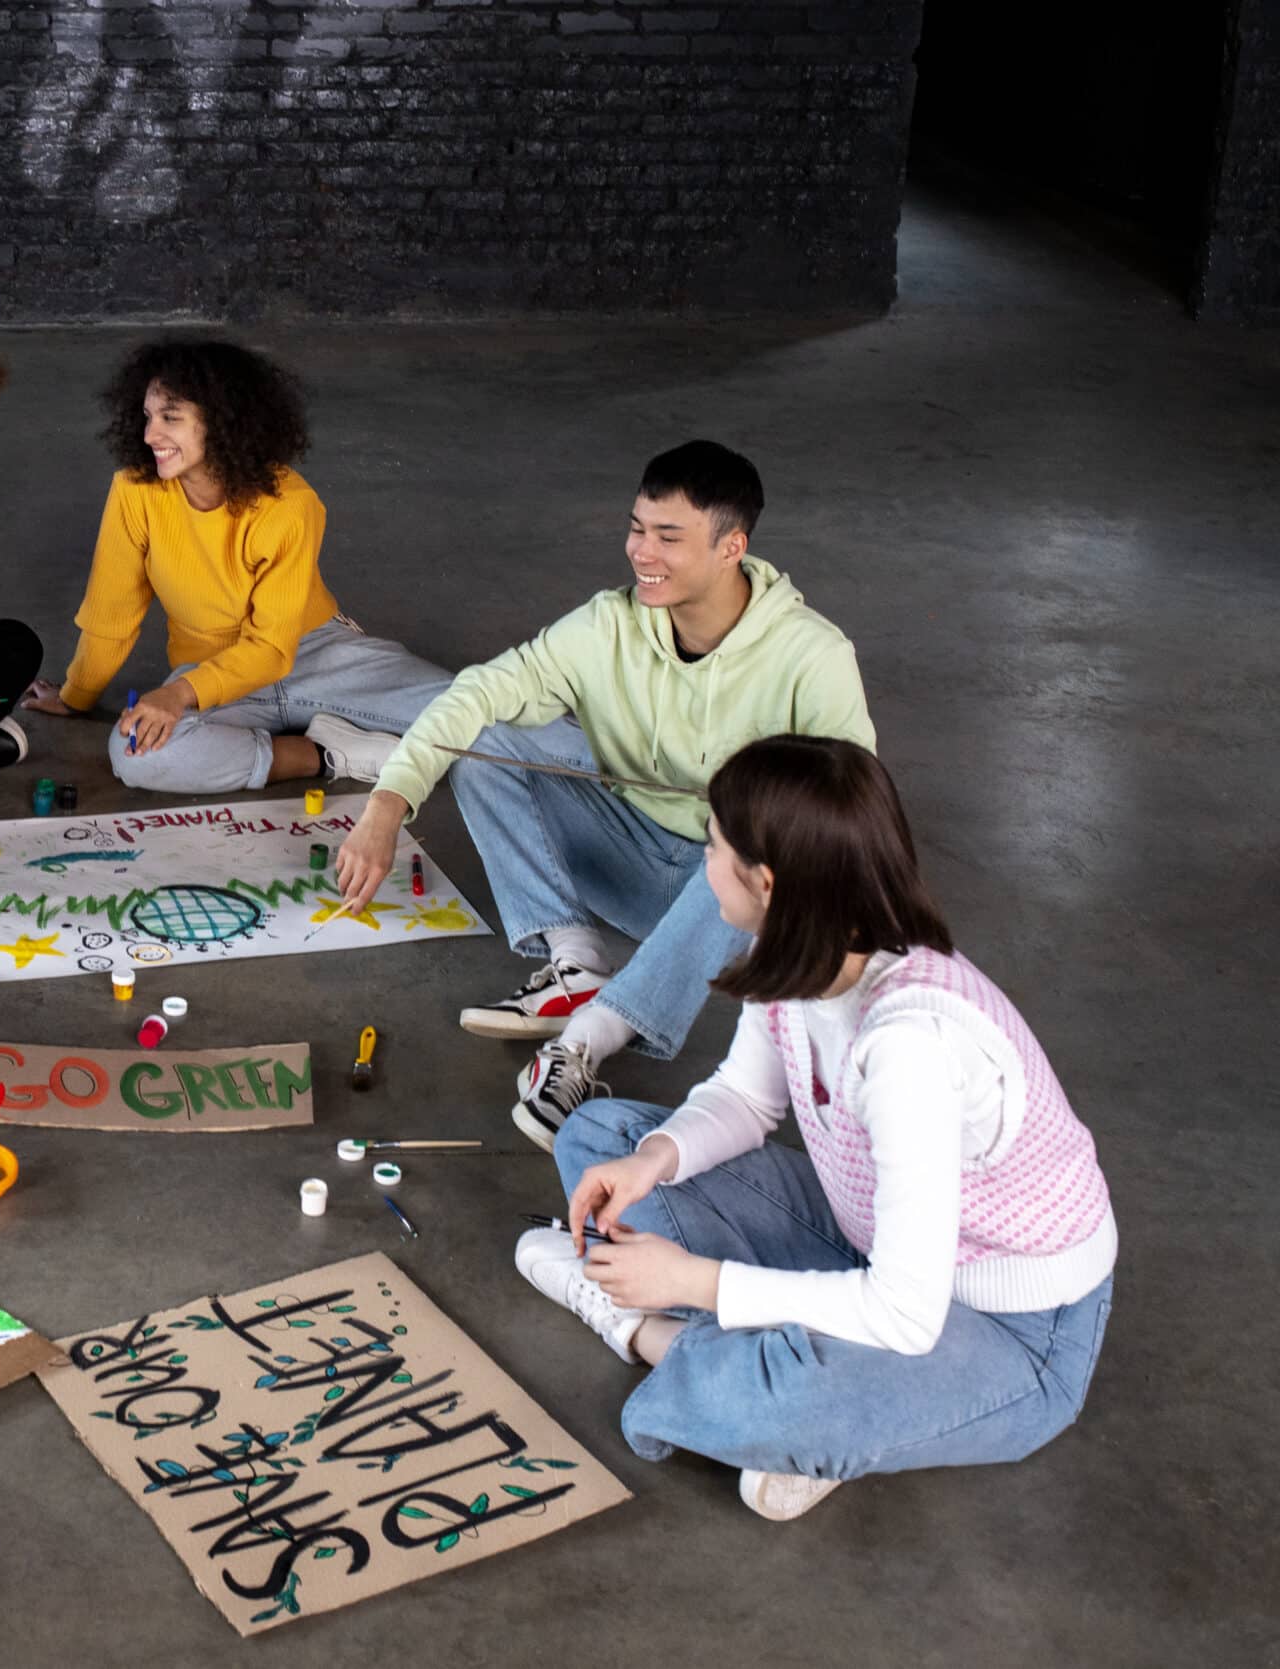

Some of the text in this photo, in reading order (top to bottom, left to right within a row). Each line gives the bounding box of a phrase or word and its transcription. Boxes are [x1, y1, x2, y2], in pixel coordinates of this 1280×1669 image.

[119, 1055, 312, 1121] GREEN
[70, 1315, 371, 1600] SAVE OUR
[211, 1288, 576, 1550] PLANET
